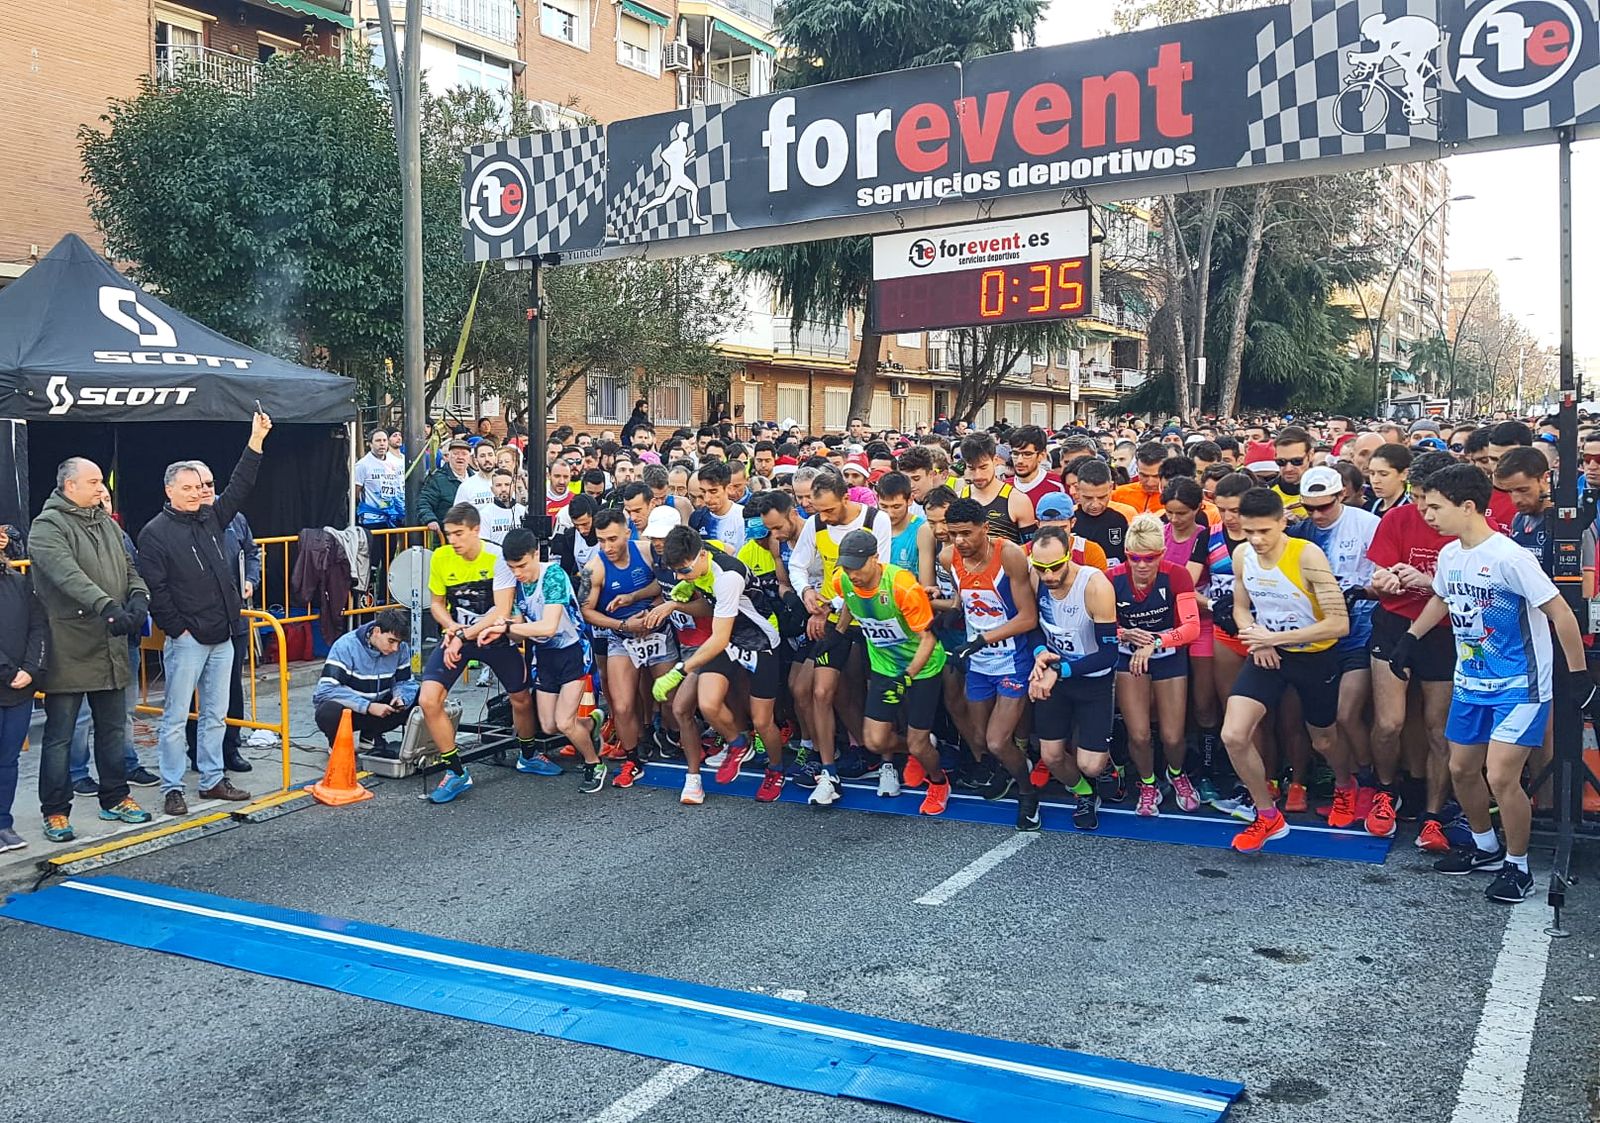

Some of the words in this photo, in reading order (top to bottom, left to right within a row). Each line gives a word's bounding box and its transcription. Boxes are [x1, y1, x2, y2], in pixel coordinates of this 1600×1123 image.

[762, 42, 1194, 193] forevent
[856, 169, 1001, 208] servicios
[1007, 143, 1196, 188] deportivos
[939, 231, 1050, 258] forevent.es
[958, 254, 986, 266] servicios
[987, 251, 1020, 264] deportivos
[980, 261, 1084, 318] 0:35
[94, 351, 254, 370] SCOTT
[77, 386, 197, 406] SCOTT
[1130, 606, 1169, 619] MARATHON
[862, 627, 897, 639] 1201
